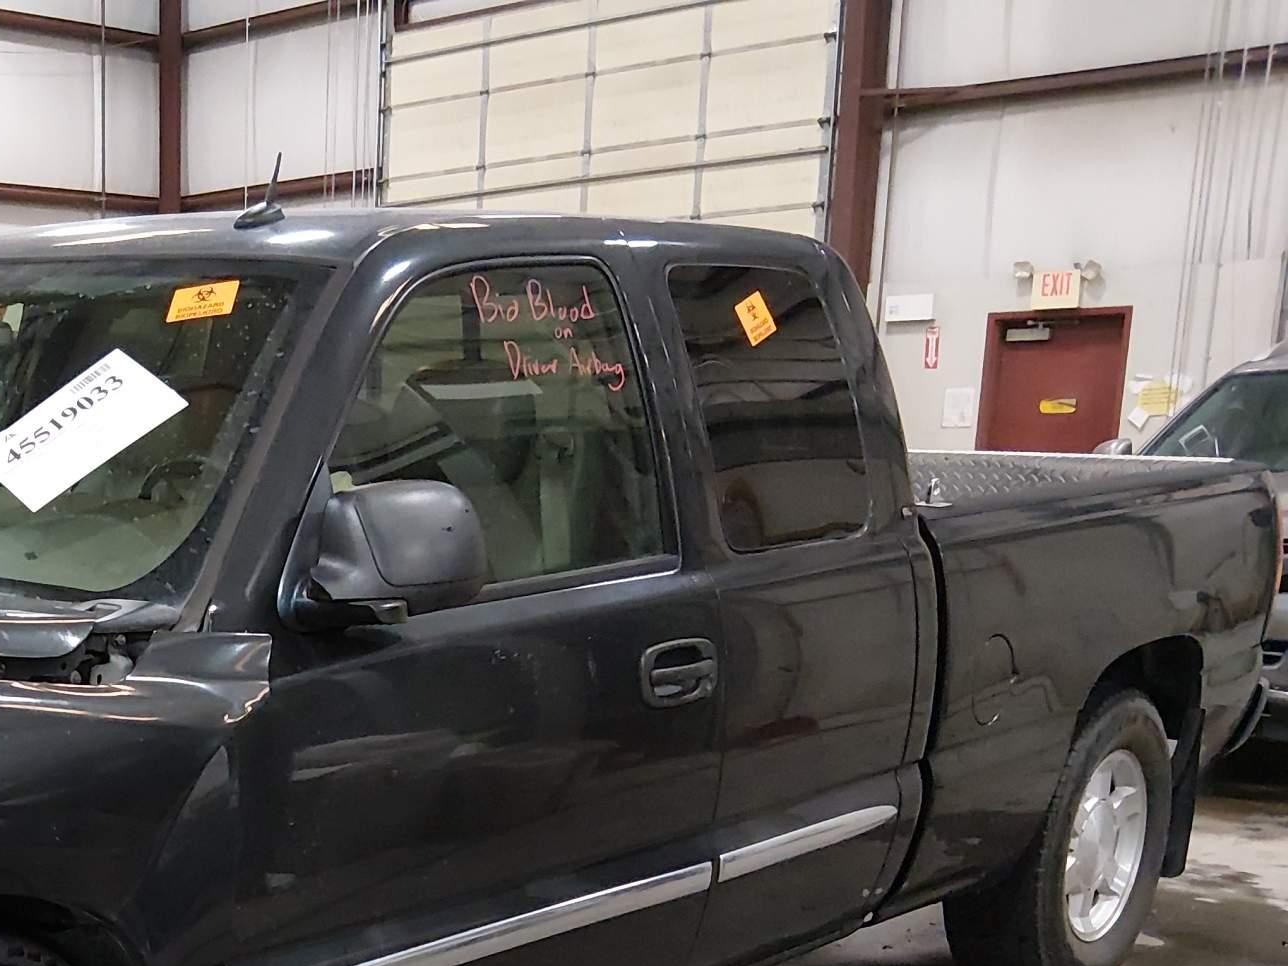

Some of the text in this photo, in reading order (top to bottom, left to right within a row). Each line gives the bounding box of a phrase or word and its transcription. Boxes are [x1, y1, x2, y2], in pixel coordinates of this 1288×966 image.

[470, 275, 596, 323] Bio Blood
[1041, 272, 1073, 297] EXIT
[554, 325, 574, 340] on
[503, 341, 626, 391] Driver Airbag
[7, 375, 124, 464] 45519033
